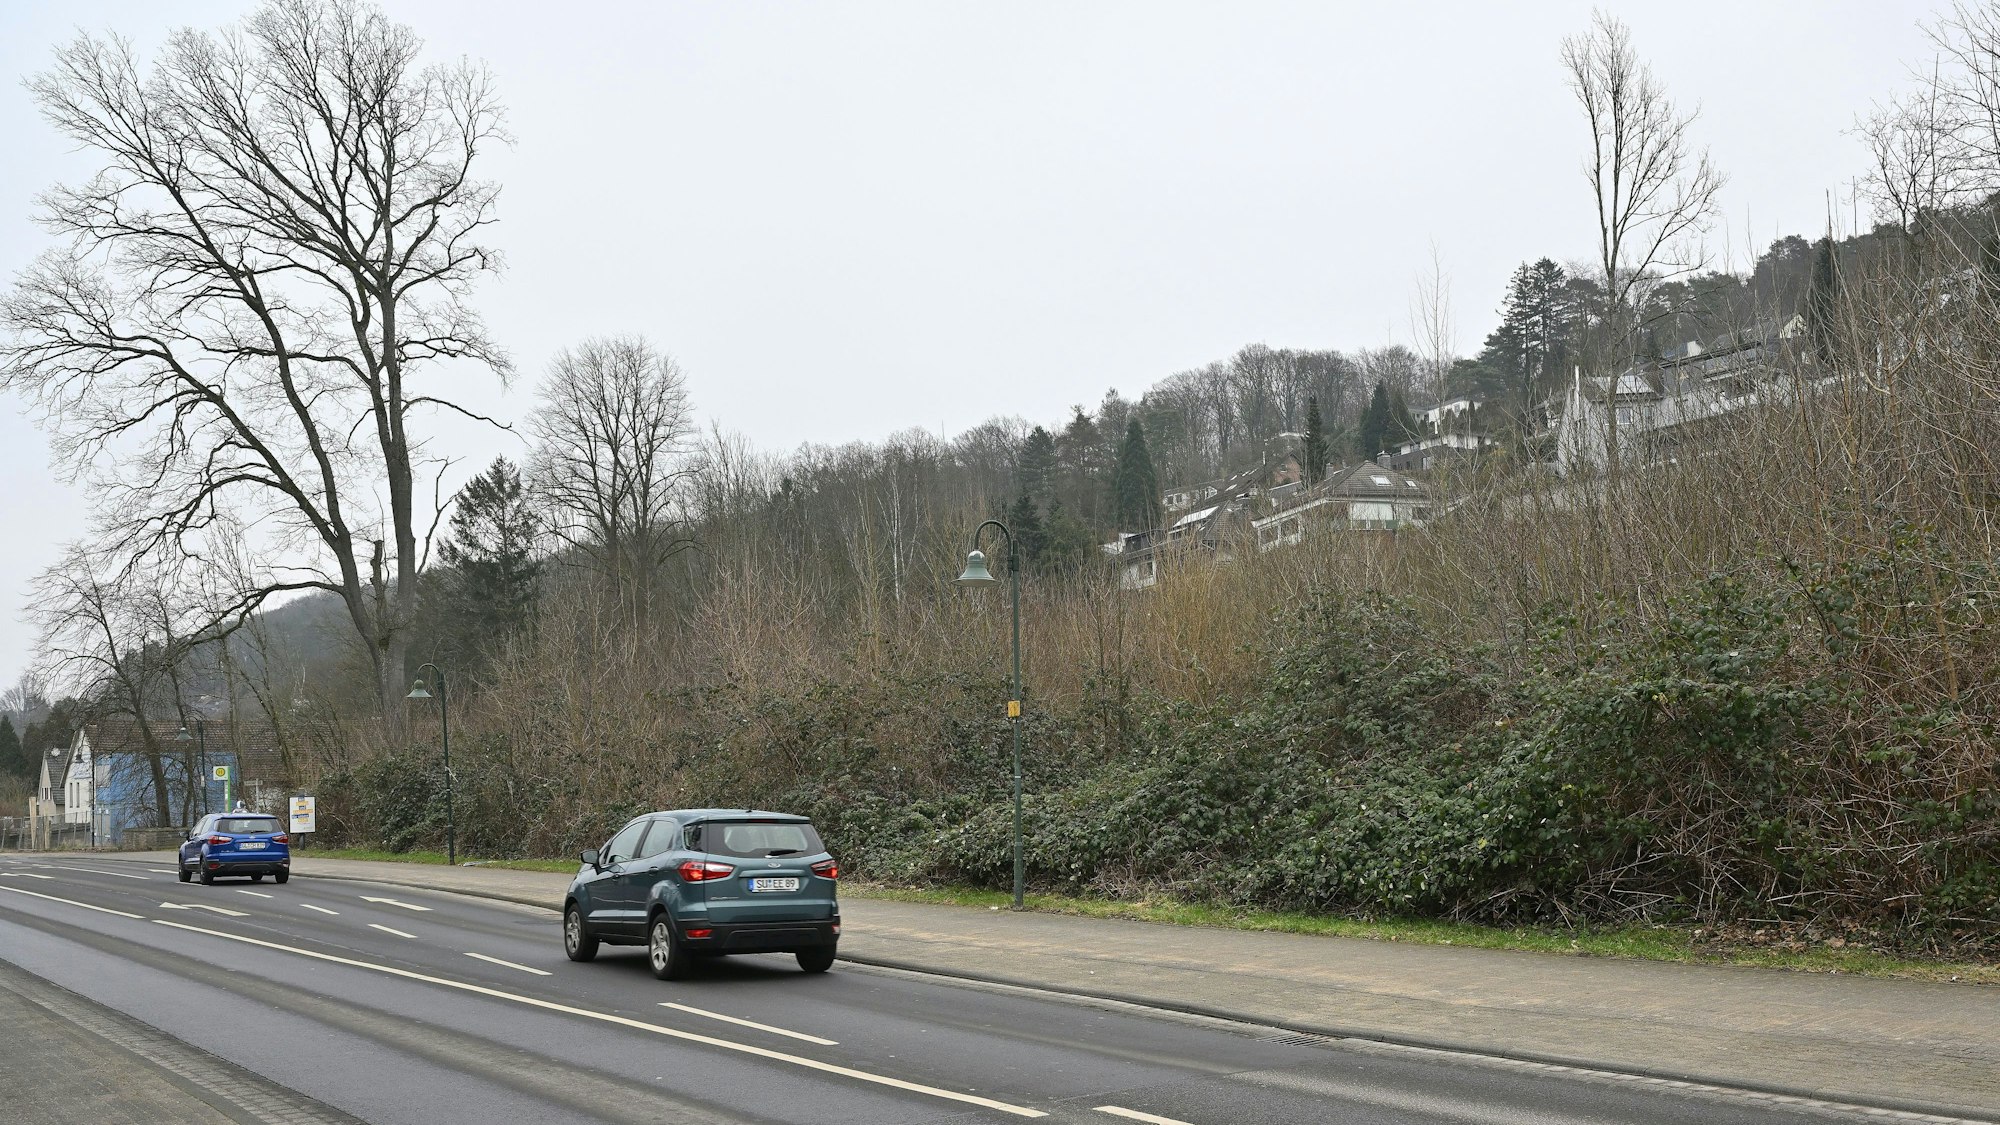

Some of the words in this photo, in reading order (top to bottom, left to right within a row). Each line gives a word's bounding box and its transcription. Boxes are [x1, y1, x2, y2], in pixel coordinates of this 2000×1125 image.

[756, 879, 768, 889] SU
[773, 879, 784, 888] EE
[785, 879, 795, 888] 89
